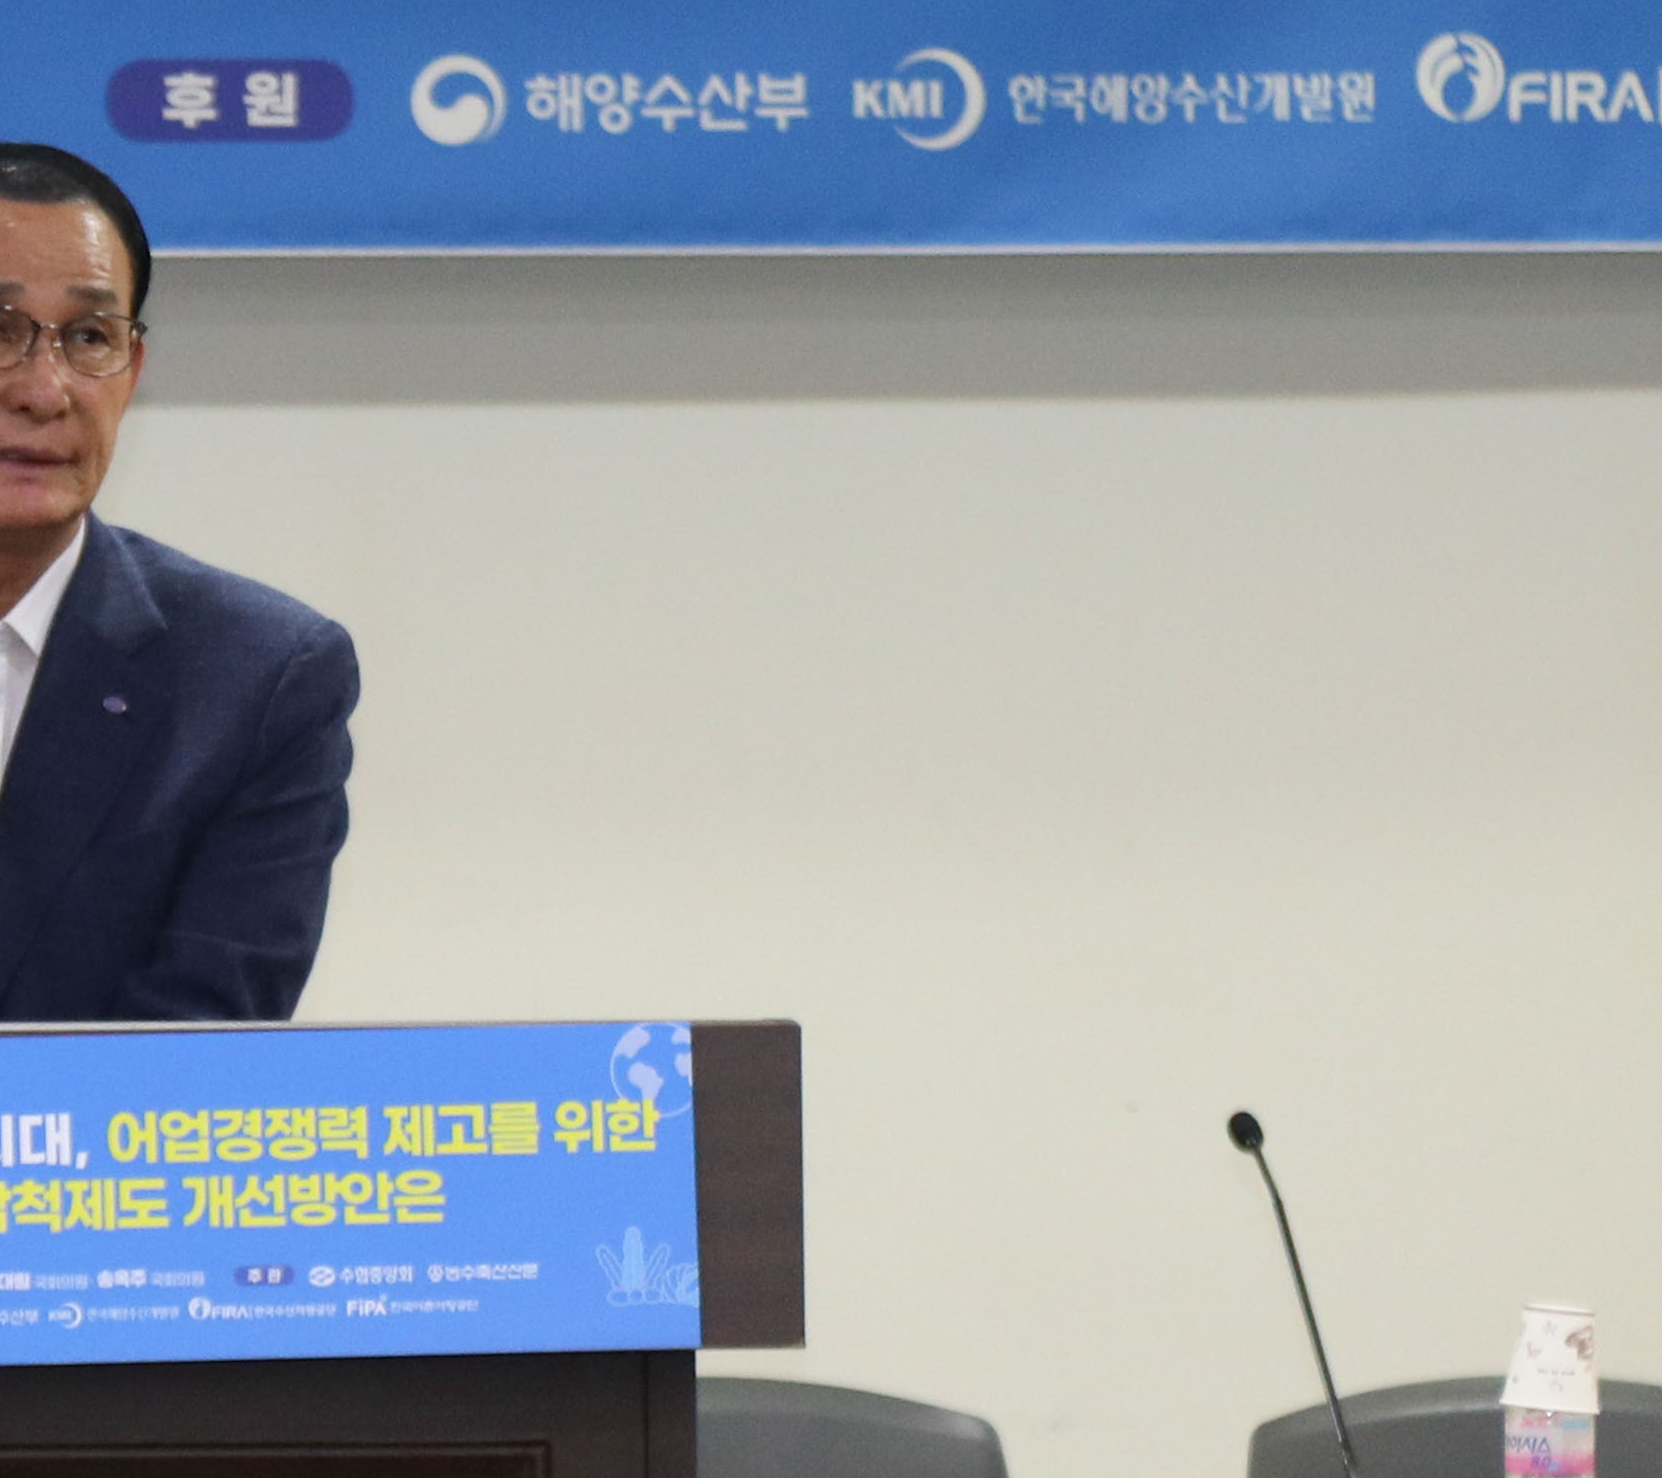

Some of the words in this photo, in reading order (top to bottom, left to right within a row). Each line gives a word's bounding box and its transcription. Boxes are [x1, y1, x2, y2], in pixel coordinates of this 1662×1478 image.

[524, 72, 810, 135] 해양수산부
[852, 79, 944, 120] KMI
[1007, 71, 1377, 125] 한국해양수산개발원
[1507, 72, 1653, 124] FIRA
[106, 1105, 370, 1165] 어업경쟁력
[382, 1101, 541, 1159] 제고를
[553, 1096, 660, 1154] 위한
[181, 1169, 446, 1229] 개선방안은
